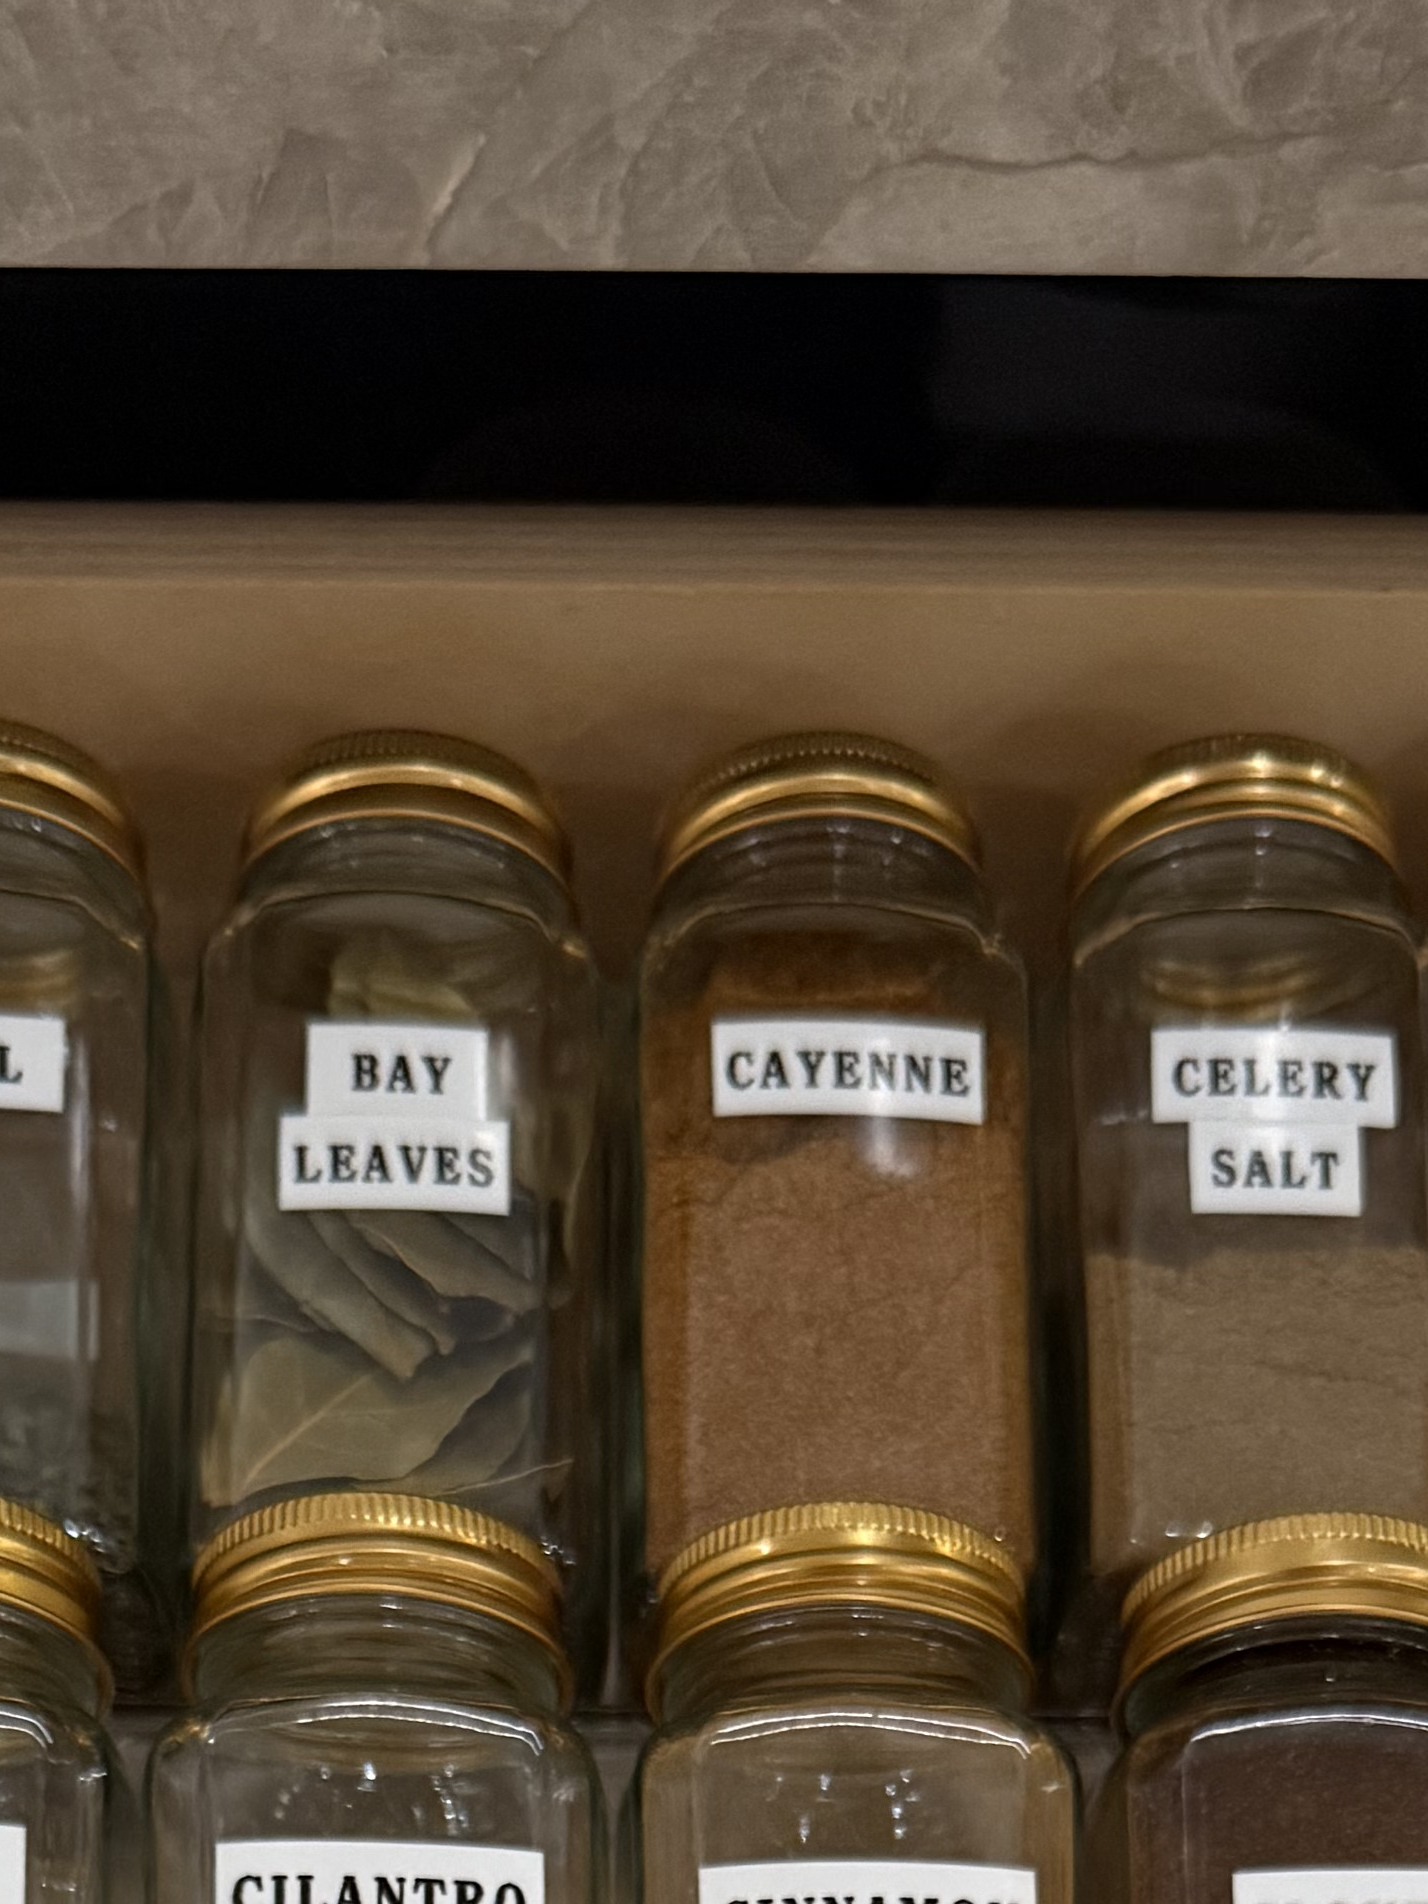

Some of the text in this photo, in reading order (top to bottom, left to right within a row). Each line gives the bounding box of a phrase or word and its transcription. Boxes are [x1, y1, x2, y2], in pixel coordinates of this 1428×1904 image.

[352, 1053, 451, 1094] BAY
[726, 1050, 969, 1096] CAYENNE
[1175, 1055, 1376, 1101] CELERY
[294, 1144, 493, 1187] LEAVES
[1213, 1148, 1338, 1189] SALT
